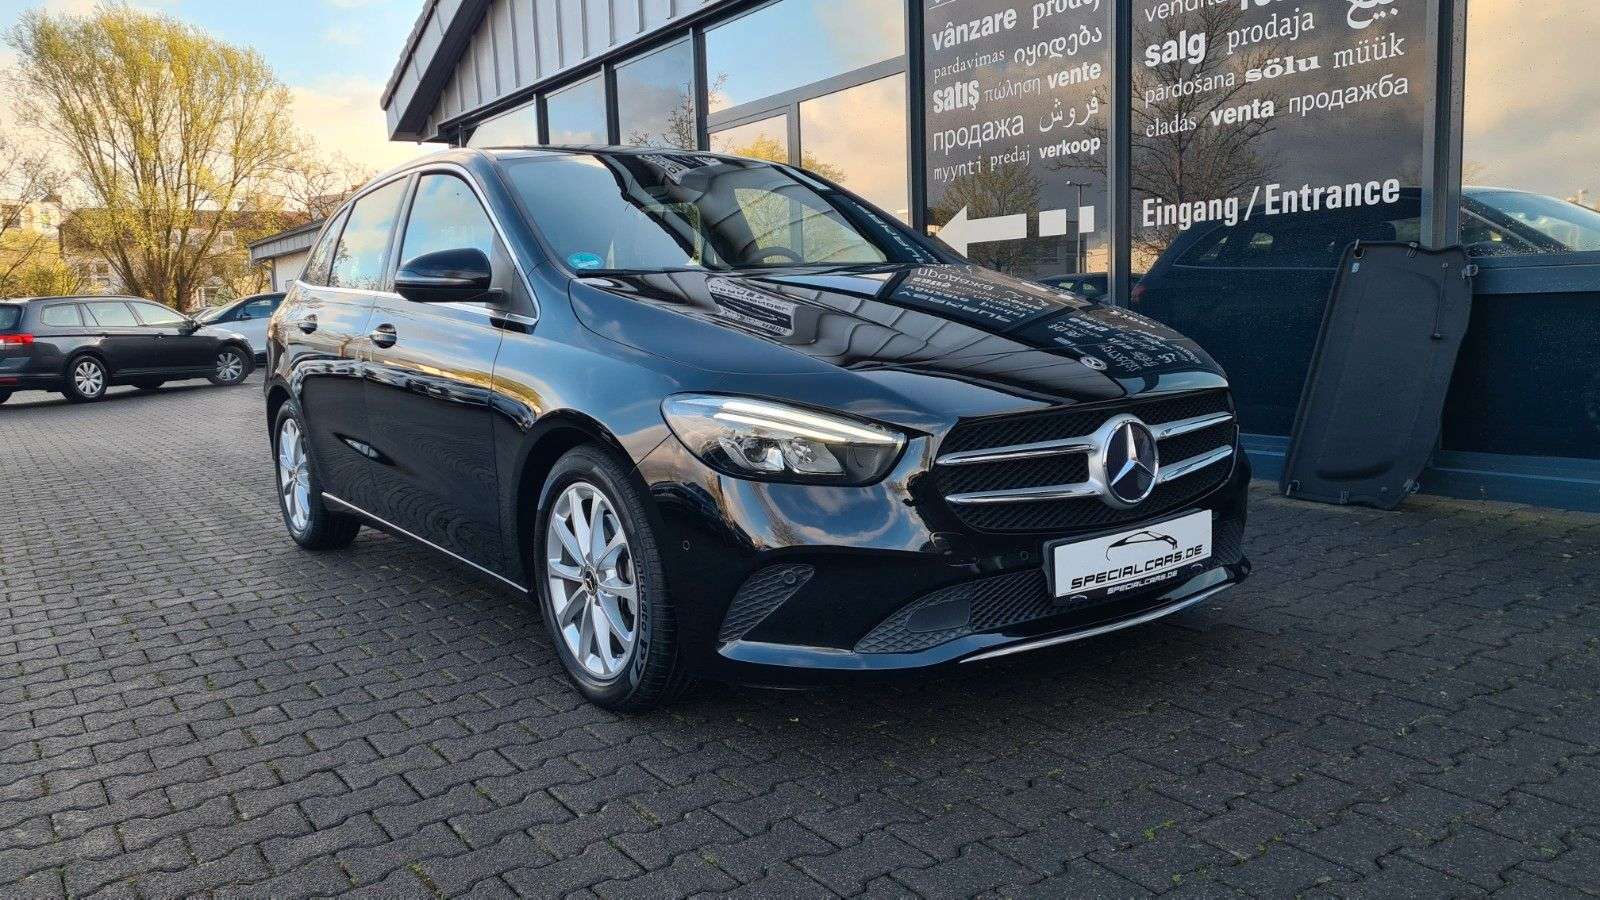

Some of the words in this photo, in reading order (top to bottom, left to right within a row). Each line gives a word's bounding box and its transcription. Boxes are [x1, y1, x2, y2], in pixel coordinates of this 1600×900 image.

[931, 8, 1017, 50] vânzare
[1032, 0, 1100, 30] pro
[1145, 0, 1226, 22] vend
[1144, 30, 1206, 67] salg
[1226, 8, 1315, 54] prodaja
[1245, 55, 1320, 83] sölu
[1333, 32, 1405, 69] müük
[933, 50, 1005, 83] pardavimas
[1047, 62, 1101, 89] vente
[932, 80, 980, 113] satış
[984, 77, 1041, 102] πώληση
[1039, 89, 1099, 132] فروش
[1288, 73, 1409, 117] продажба
[933, 115, 1025, 155] продажа
[1145, 113, 1197, 138] eladás
[1209, 98, 1275, 126] venta
[933, 156, 982, 183] myynti
[990, 145, 1030, 171] predaj
[1039, 137, 1101, 159] verkoop
[1142, 198, 1239, 231] Eingang
[1265, 178, 1400, 215] Entrance
[1070, 544, 1203, 590] SPECIALCARS.DE
